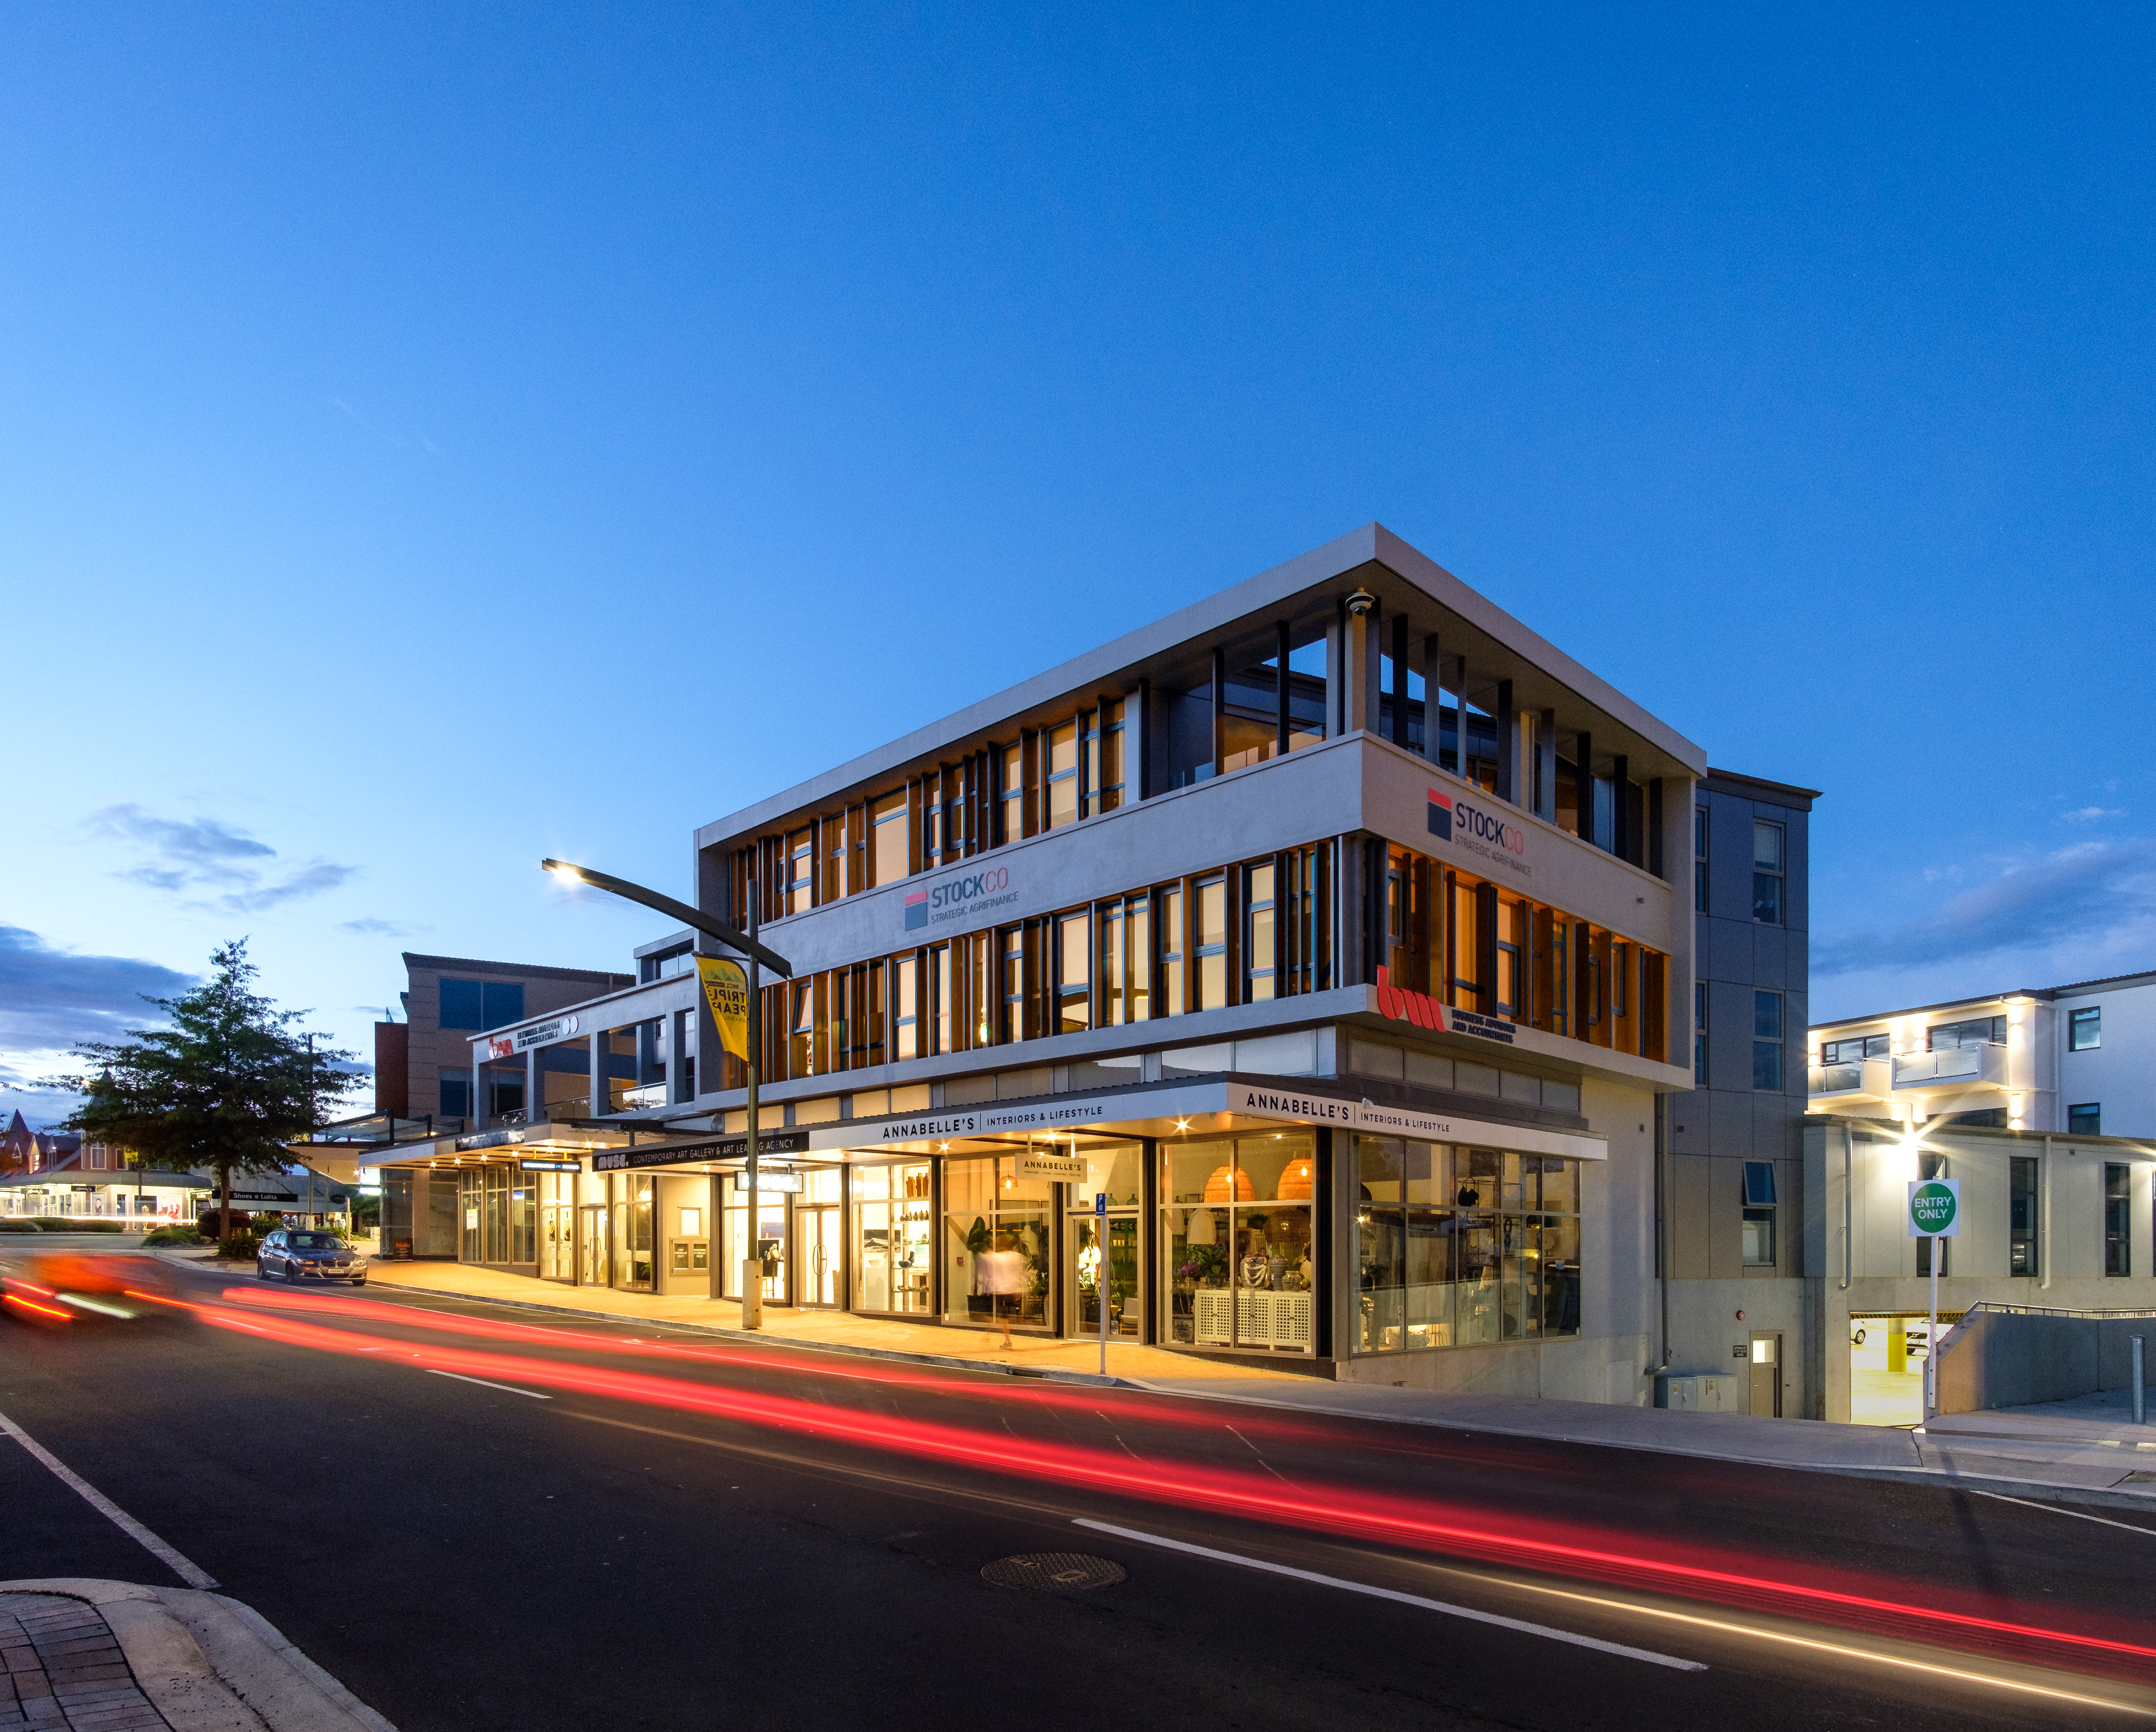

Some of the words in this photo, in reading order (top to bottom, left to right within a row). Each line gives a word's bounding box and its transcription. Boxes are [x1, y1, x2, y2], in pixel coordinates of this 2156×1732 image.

[1456, 802, 1523, 855] STOCKCO
[1455, 834, 1490, 858] STRATEGIC
[1491, 851, 1532, 877] AGRIFINANCE
[932, 867, 1008, 909] STOCKCO
[931, 906, 968, 924] STRATEGIC
[969, 891, 1019, 914] AGRIFINANCE
[1452, 1008, 1484, 1026] BUSINESS
[1485, 1018, 1516, 1034] ADVISORS
[1452, 1020, 1467, 1033] AND
[1467, 1024, 1514, 1043] ACCOUNTANTS
[883, 1117, 975, 1139] ANNABELLE'S
[987, 1114, 1035, 1126] INTERIORS
[1039, 1112, 1046, 1121] &
[1050, 1106, 1103, 1120] LIFESTYLE
[1247, 1093, 1349, 1120] ANNABELLE'S
[1361, 1112, 1402, 1126] INTERIORS
[1412, 1120, 1450, 1133] LIFESTYLE
[633, 1152, 676, 1164] CONTEMPORARY
[690, 1147, 715, 1158] GALLERY
[723, 1145, 734, 1154] ART
[736, 1142, 763, 1153] LEAG
[766, 1138, 794, 1150] AGENCY
[1024, 1161, 1081, 1171] ANNABELLE'S
[1098, 1194, 1102, 1203] P
[1915, 1197, 1951, 1207] ENTRY
[1918, 1208, 1948, 1219] ONLY
